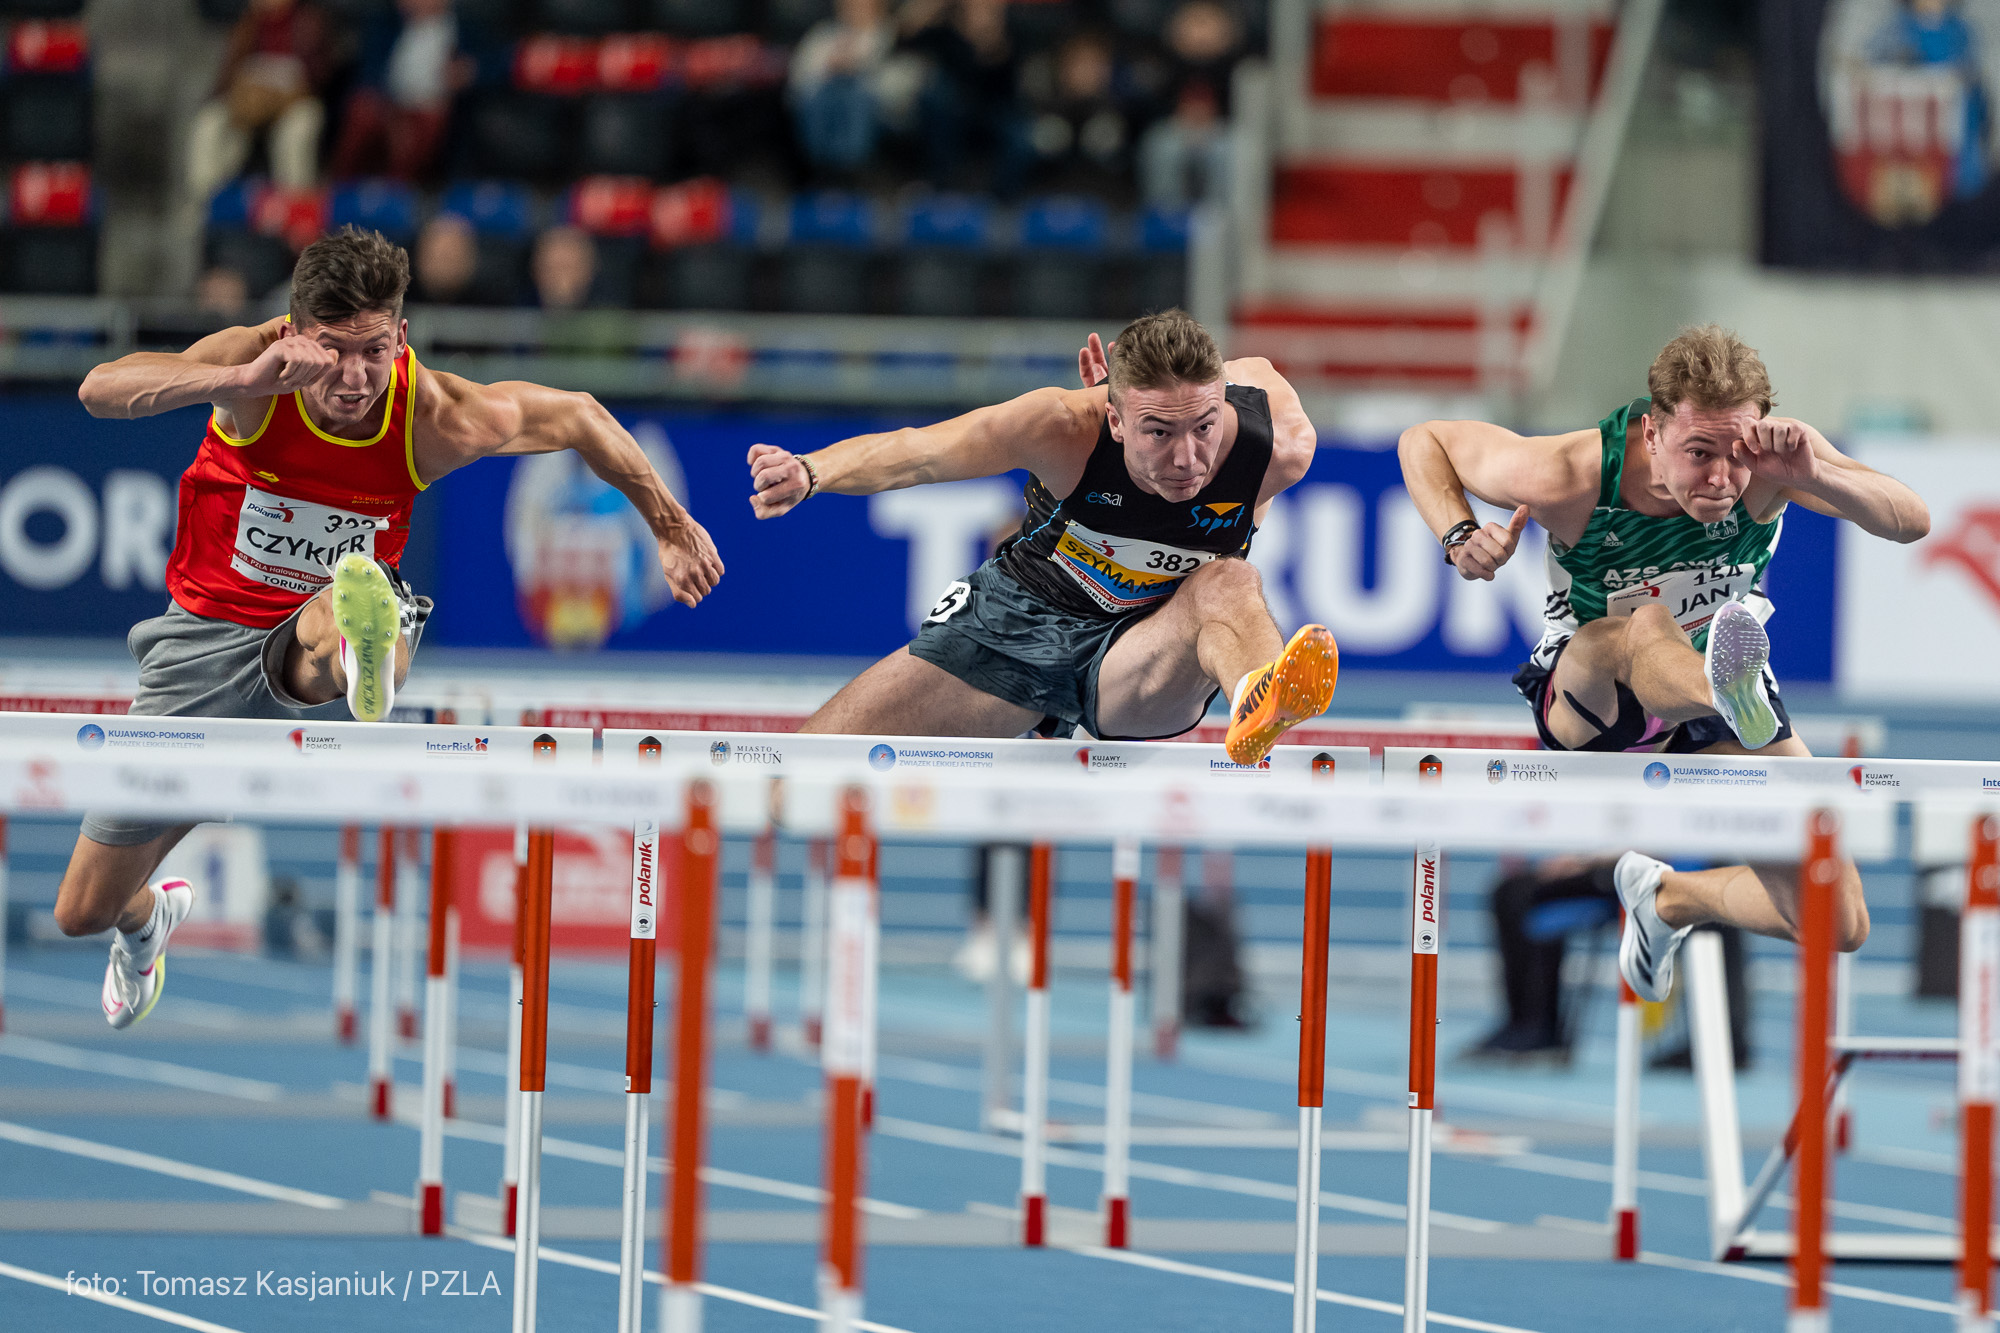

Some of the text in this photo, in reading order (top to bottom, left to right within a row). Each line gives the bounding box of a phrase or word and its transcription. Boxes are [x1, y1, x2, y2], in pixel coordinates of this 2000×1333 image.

[247, 503, 283, 519] polanik
[1187, 505, 1246, 536] Sopot
[246, 526, 366, 566] CZYKIER
[1601, 539, 1624, 547] adidas
[1065, 540, 1178, 594] SZYMAŃSK
[1146, 550, 1201, 573] 382
[250, 560, 268, 571] PZLA
[269, 567, 300, 577] Halowe
[301, 573, 334, 583] Mistrzos
[1603, 566, 1660, 581] AZS
[1693, 565, 1743, 586] 154
[263, 575, 324, 593] TORUŃ 20
[1086, 578, 1111, 599] Halowe
[930, 588, 962, 617] 5
[108, 729, 205, 740] KUJAWSKO-POMORSKI
[306, 736, 335, 744] KUJAWY
[426, 741, 474, 752] InterRisk
[737, 745, 773, 753] MIASTO
[734, 750, 783, 764] TORUŃ
[899, 749, 993, 759] KUJAWSKO-POMORSKI
[1092, 761, 1127, 769] POMORZE
[1513, 763, 1549, 771] MIASTO
[1673, 767, 1767, 777] KUJAWSKO-POMORSKI
[1511, 768, 1558, 782] TORUŃ
[1983, 777, 2000, 787] Inte
[1865, 779, 1900, 787] POMORZE
[637, 841, 653, 907] polanik
[1420, 858, 1436, 923] polanik
